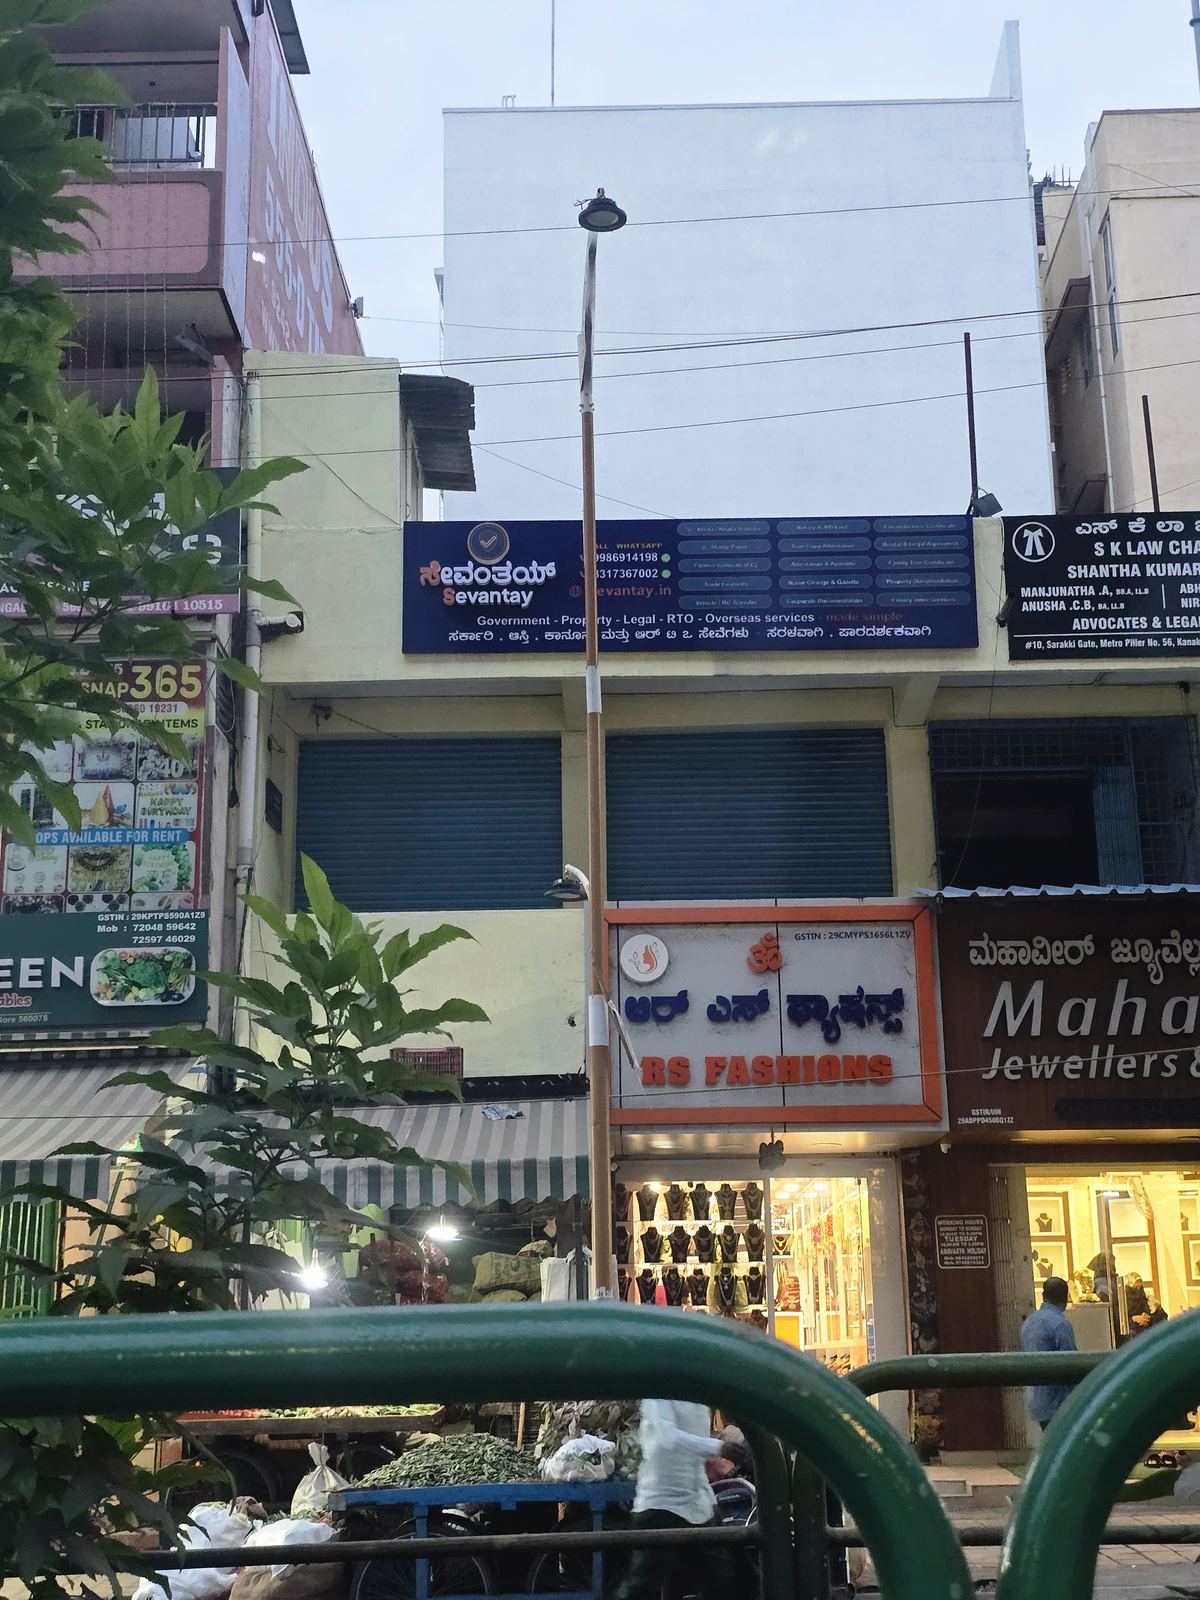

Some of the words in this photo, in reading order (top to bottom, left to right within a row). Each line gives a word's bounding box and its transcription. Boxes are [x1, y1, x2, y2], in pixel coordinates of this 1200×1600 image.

[1094, 542, 1105, 557] S
[1110, 541, 1122, 556] K
[1127, 541, 1163, 556] LAW
[1067, 564, 1142, 579] SHANTHA
[443, 587, 534, 608] Sevantay
[597, 584, 672, 599] evantay.in
[1020, 586, 1096, 598] MANJUNATHA
[184, 600, 223, 611] 10515
[1021, 600, 1066, 612] ANUSHA
[477, 615, 550, 626] Government
[561, 615, 612, 627] Proprty
[623, 614, 656, 626] Legal
[667, 614, 694, 624] RTO
[705, 613, 761, 624] Overseas
[765, 613, 815, 623] services
[826, 612, 859, 622] made
[861, 612, 903, 624] simple
[1072, 616, 1148, 630] ADVOCATES
[1152, 617, 1161, 629] &
[1166, 615, 1200, 628] LEGA
[1046, 639, 1076, 649] Sarakki
[1077, 639, 1099, 649] Gate,
[1100, 639, 1123, 648] Metro
[1147, 638, 1161, 647] No.
[149, 703, 178, 714] 19231
[62, 830, 122, 843] AVAILABLE
[126, 829, 150, 842] FOR
[152, 829, 182, 841] RENT
[97, 925, 118, 933] Mob
[133, 923, 163, 932] 72048
[166, 923, 197, 931] 59642
[132, 936, 163, 944] 72597
[165, 934, 196, 943] 46029
[794, 932, 821, 941] GSTIN
[982, 1043, 1179, 1080] Jewellers
[640, 1055, 691, 1086] RS
[704, 1054, 893, 1086] FASHIONS
